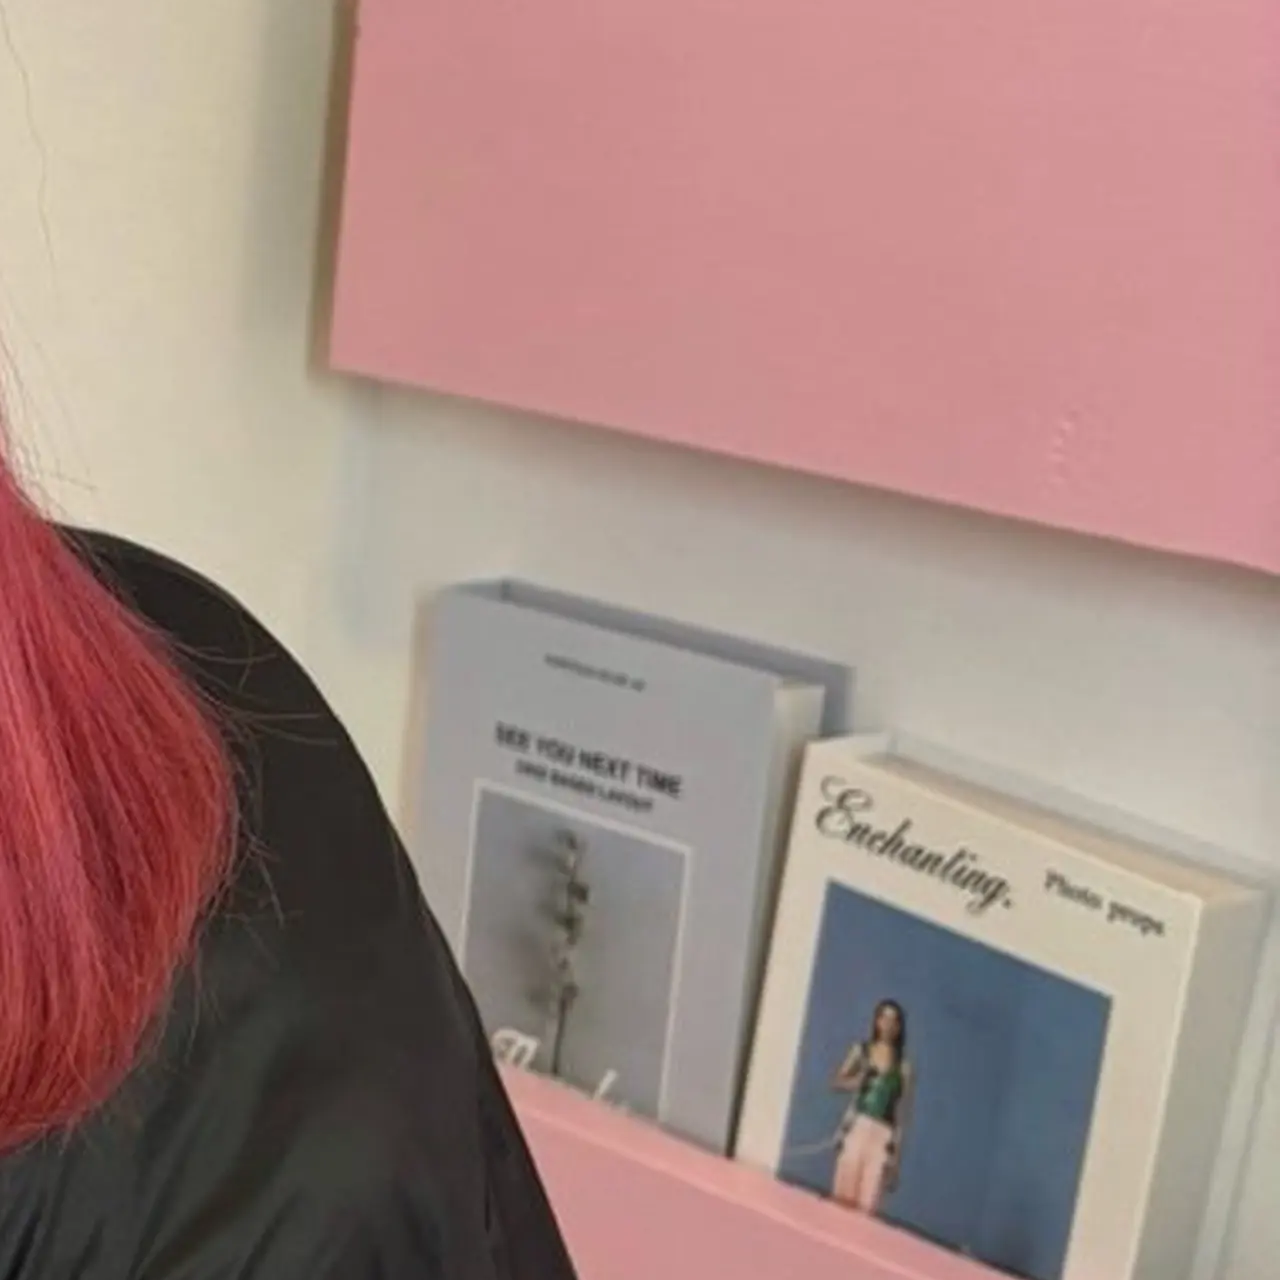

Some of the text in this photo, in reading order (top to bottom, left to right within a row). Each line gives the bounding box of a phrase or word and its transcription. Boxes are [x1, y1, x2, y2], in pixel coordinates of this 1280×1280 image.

[537, 736, 576, 767] YOU
[579, 748, 631, 784] NEXT
[637, 763, 683, 799] TIME
[1045, 869, 1103, 910] Photo
